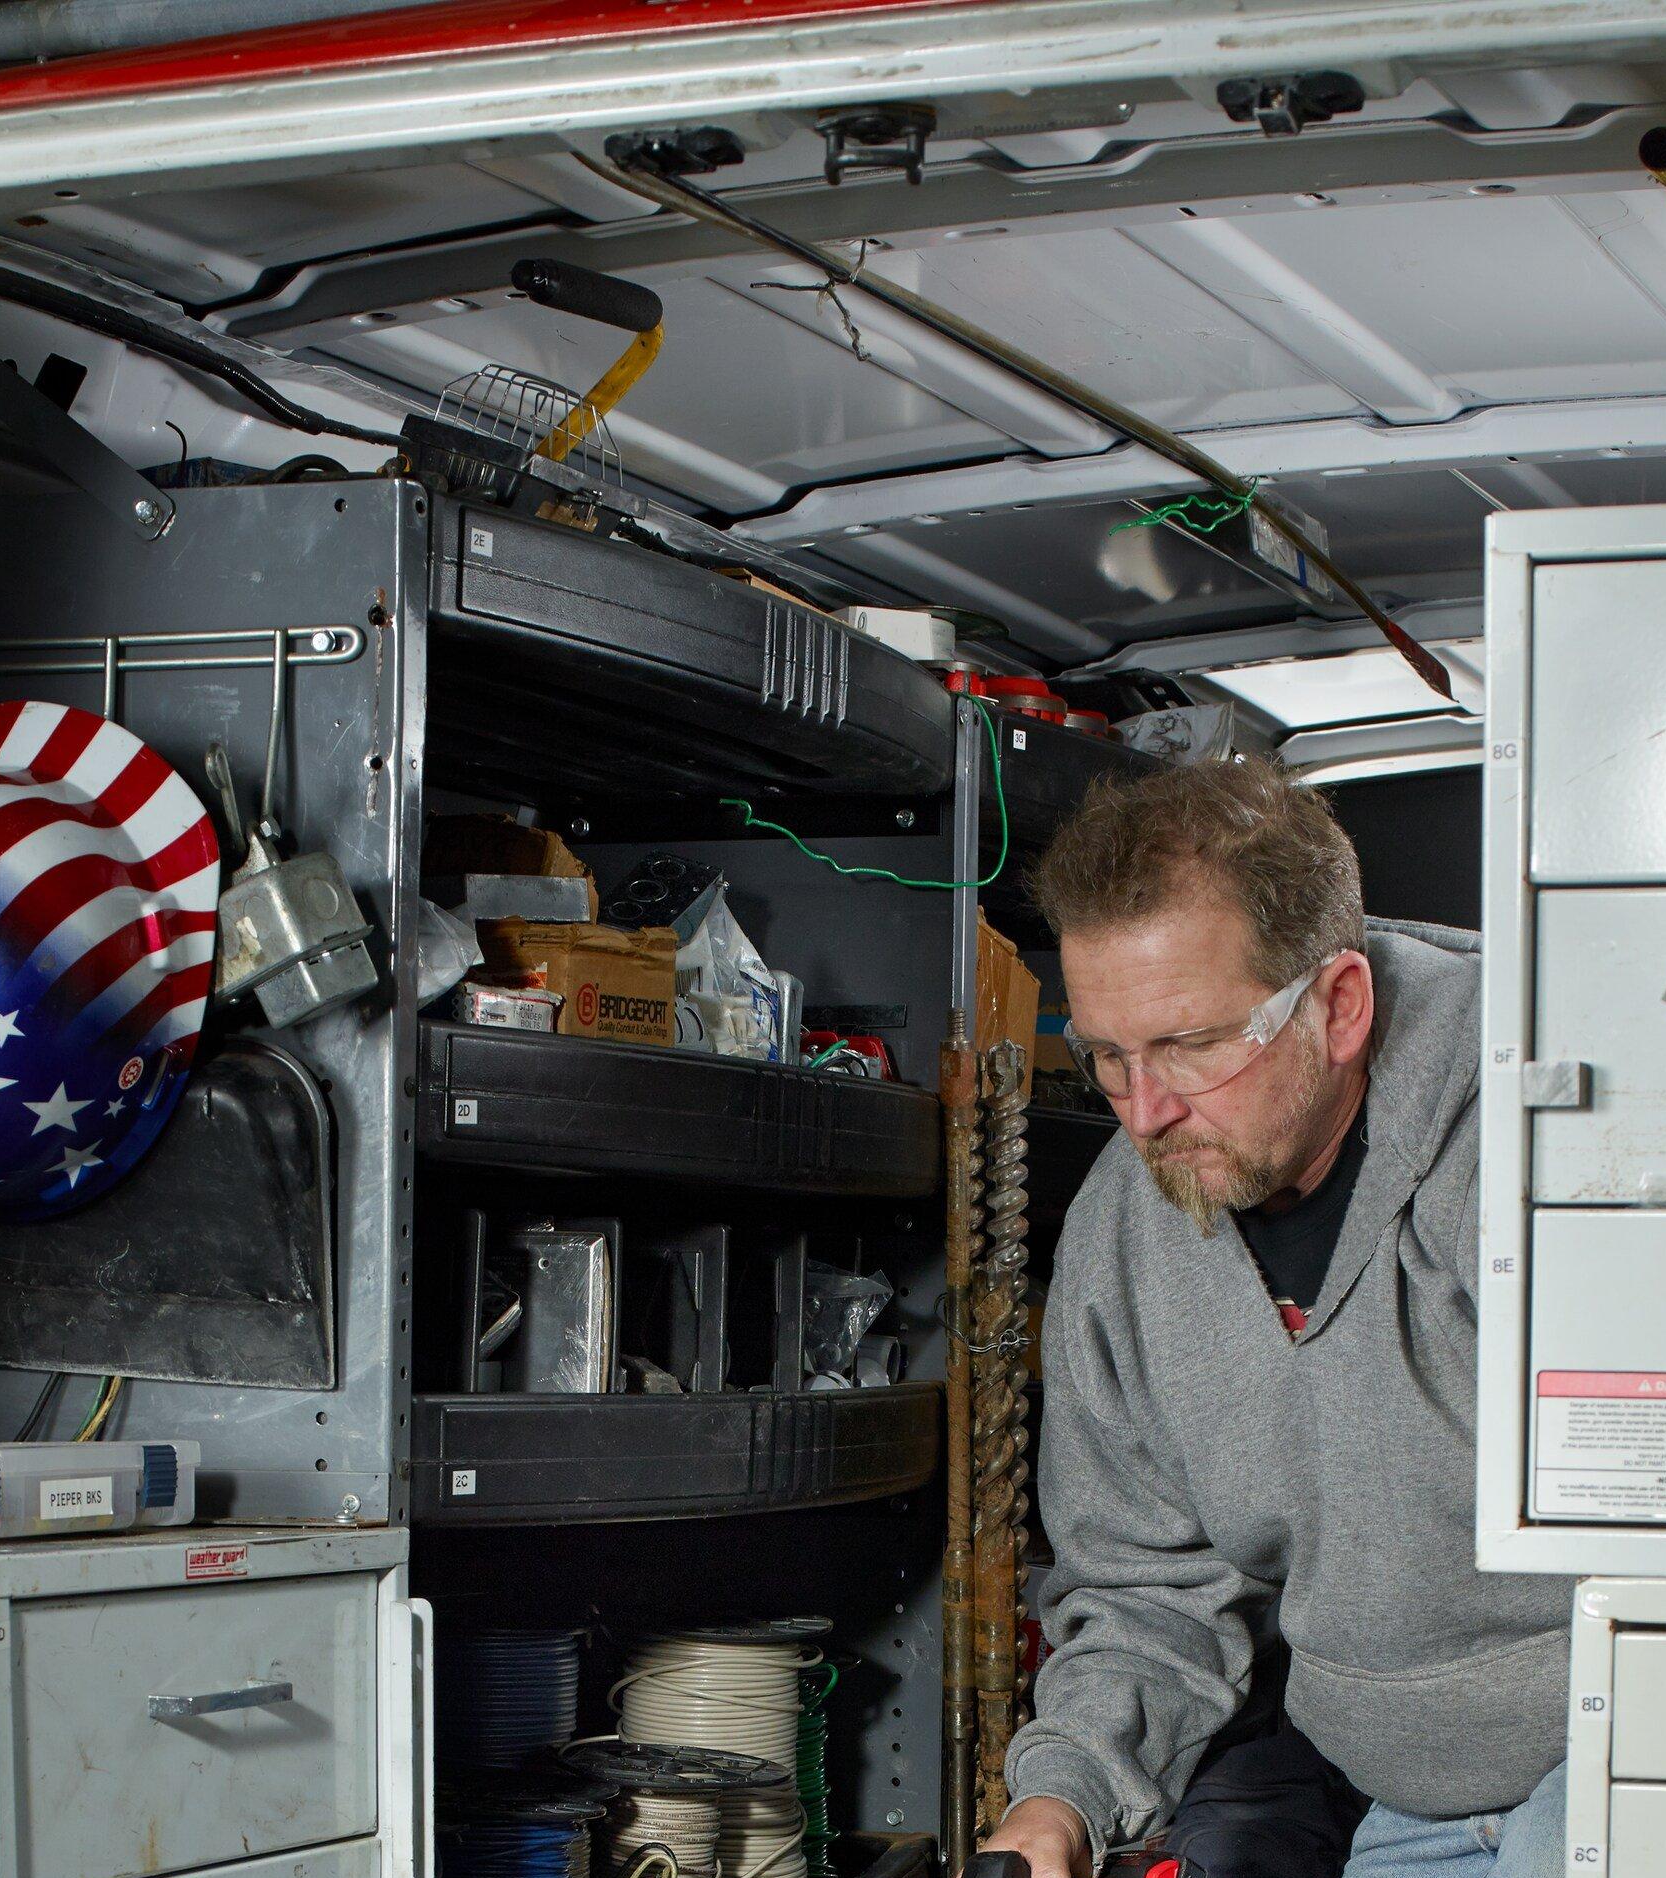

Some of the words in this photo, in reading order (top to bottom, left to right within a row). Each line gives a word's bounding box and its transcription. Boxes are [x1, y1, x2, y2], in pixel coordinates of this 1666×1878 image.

[473, 533, 485, 547] 2E
[1015, 733, 1024, 744] 3G
[1493, 743, 1517, 760] 8G
[599, 993, 668, 1025] BRIDGEPORT
[520, 1019, 541, 1030] BOLTS
[1495, 1048, 1516, 1064] 8F
[458, 1104, 471, 1117] 2D
[1493, 1258, 1515, 1274] 8E
[455, 1474, 468, 1488] 2C
[50, 1491, 83, 1507] PIEPER
[86, 1490, 102, 1505] BKS
[189, 1550, 221, 1566] weather
[222, 1547, 245, 1567] guard
[1582, 1697, 1606, 1712] 8D
[1575, 1847, 1599, 1863] 8C
